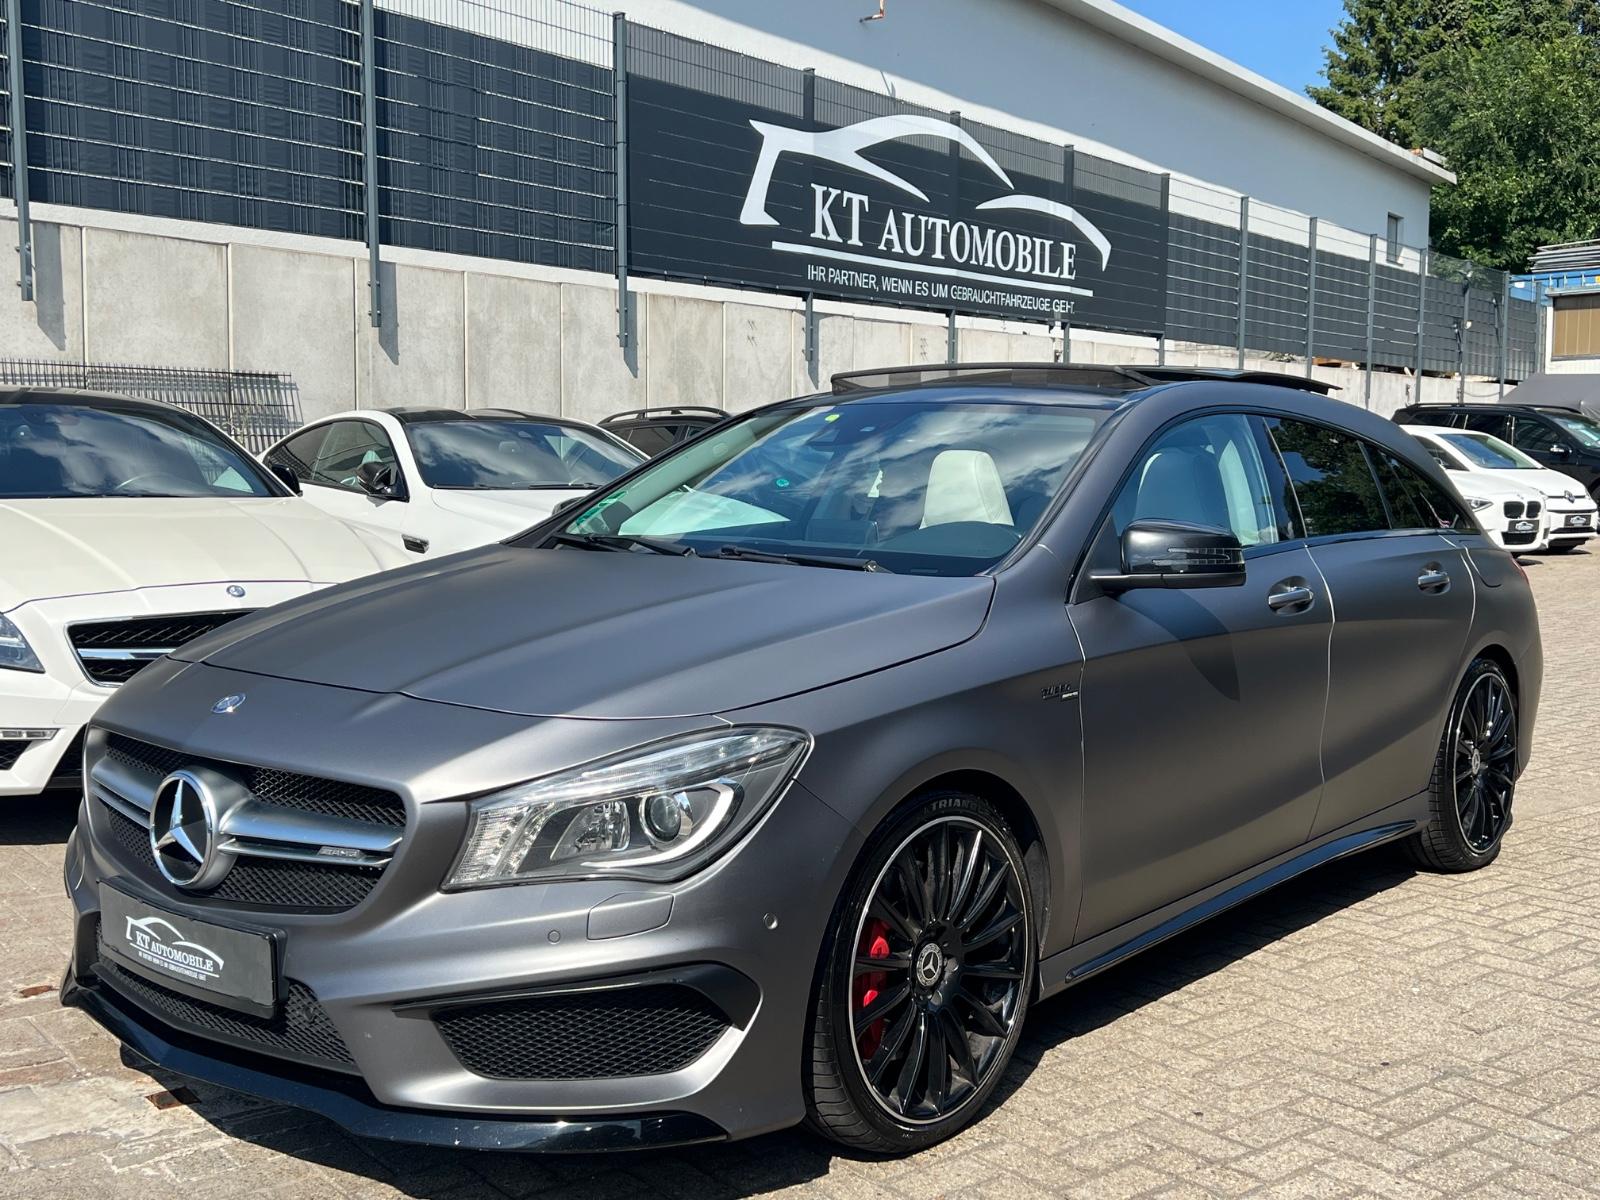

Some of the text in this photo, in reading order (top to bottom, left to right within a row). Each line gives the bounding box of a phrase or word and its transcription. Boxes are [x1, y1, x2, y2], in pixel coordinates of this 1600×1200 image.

[810, 183, 1076, 280] KT AUTOMOBILE
[808, 264, 826, 282] IHR
[828, 268, 879, 292] PARTNER,
[882, 276, 912, 295] WENN
[915, 281, 929, 297] ES
[931, 282, 948, 298] UM
[950, 285, 1050, 312] GEBRAUCHTFAHRZEUGE
[135, 931, 151, 950] KT
[151, 941, 214, 972] AUTOMOBILE
